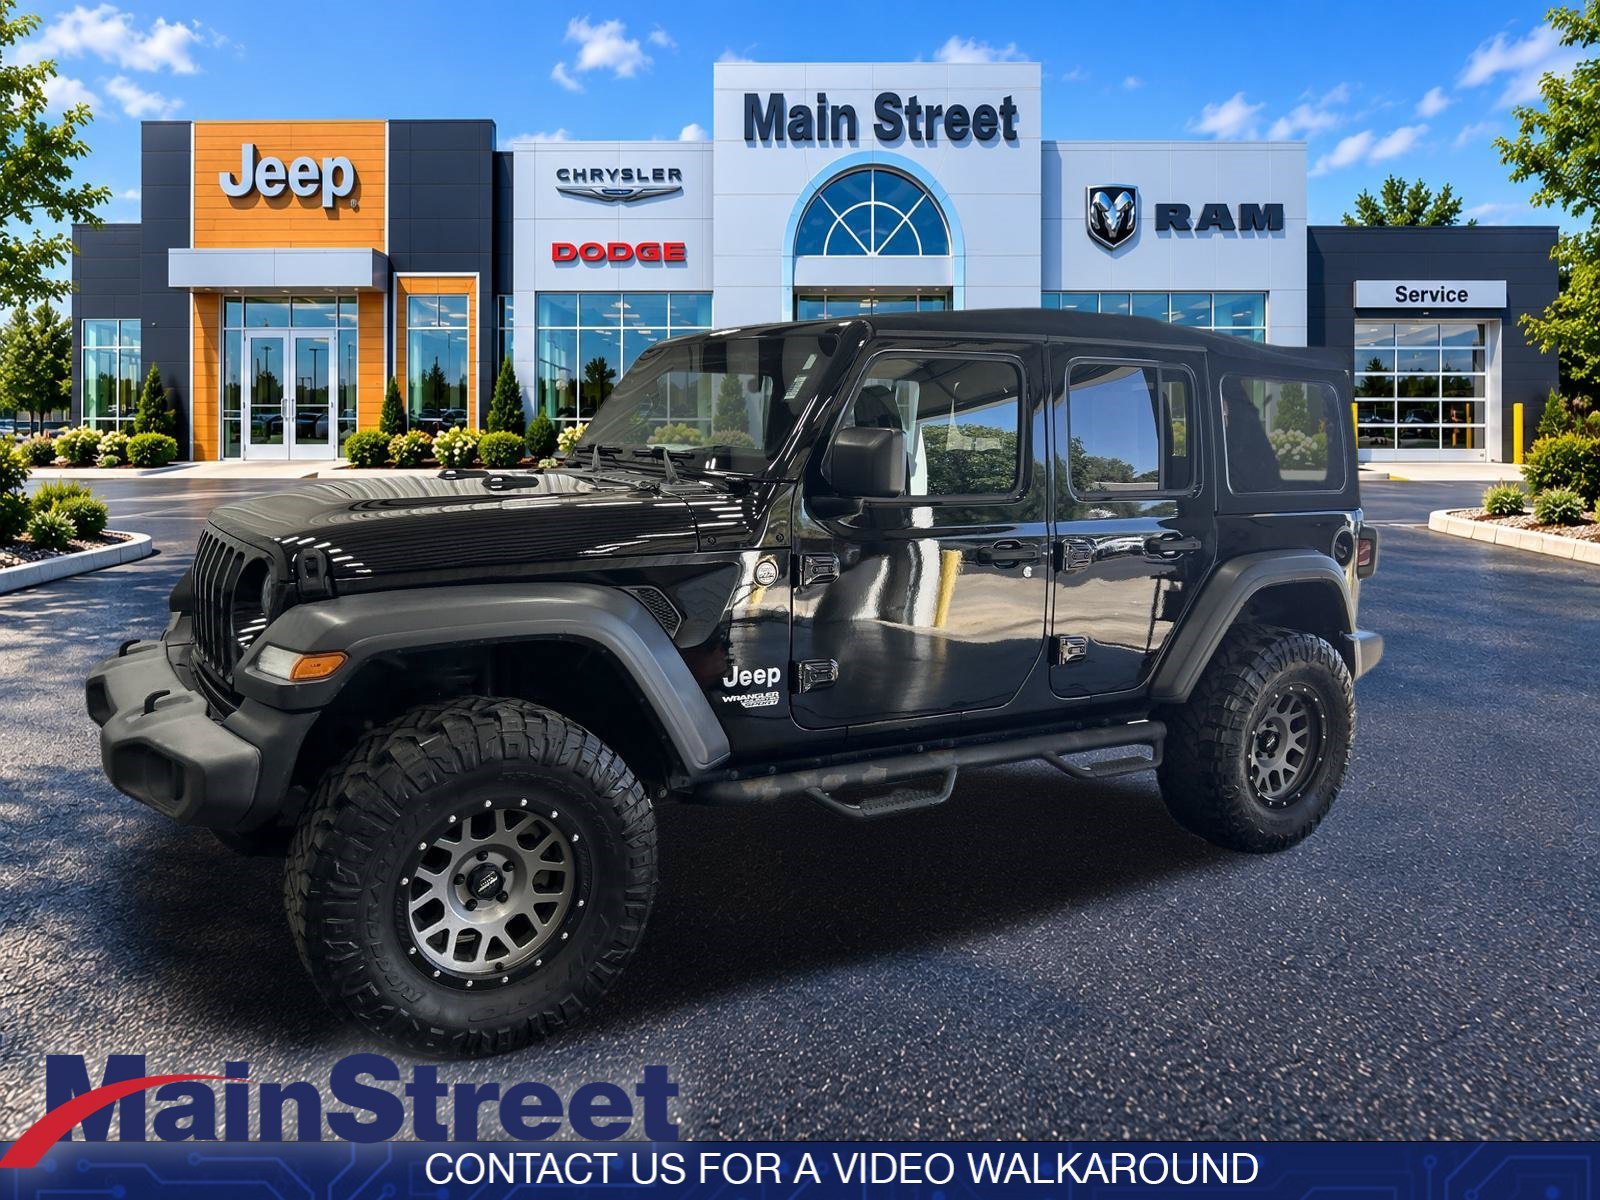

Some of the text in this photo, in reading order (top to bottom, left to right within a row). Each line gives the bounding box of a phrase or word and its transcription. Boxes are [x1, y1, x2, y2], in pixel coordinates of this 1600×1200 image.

[744, 92, 1018, 142] Main Street
[219, 144, 354, 208] Jeep
[556, 168, 682, 182] CHRYSLER
[1154, 203, 1285, 232] RAM
[551, 242, 686, 261] DODGE
[1395, 285, 1469, 303] Service
[722, 666, 781, 688] Jeep
[721, 691, 780, 703] WRANGLER
